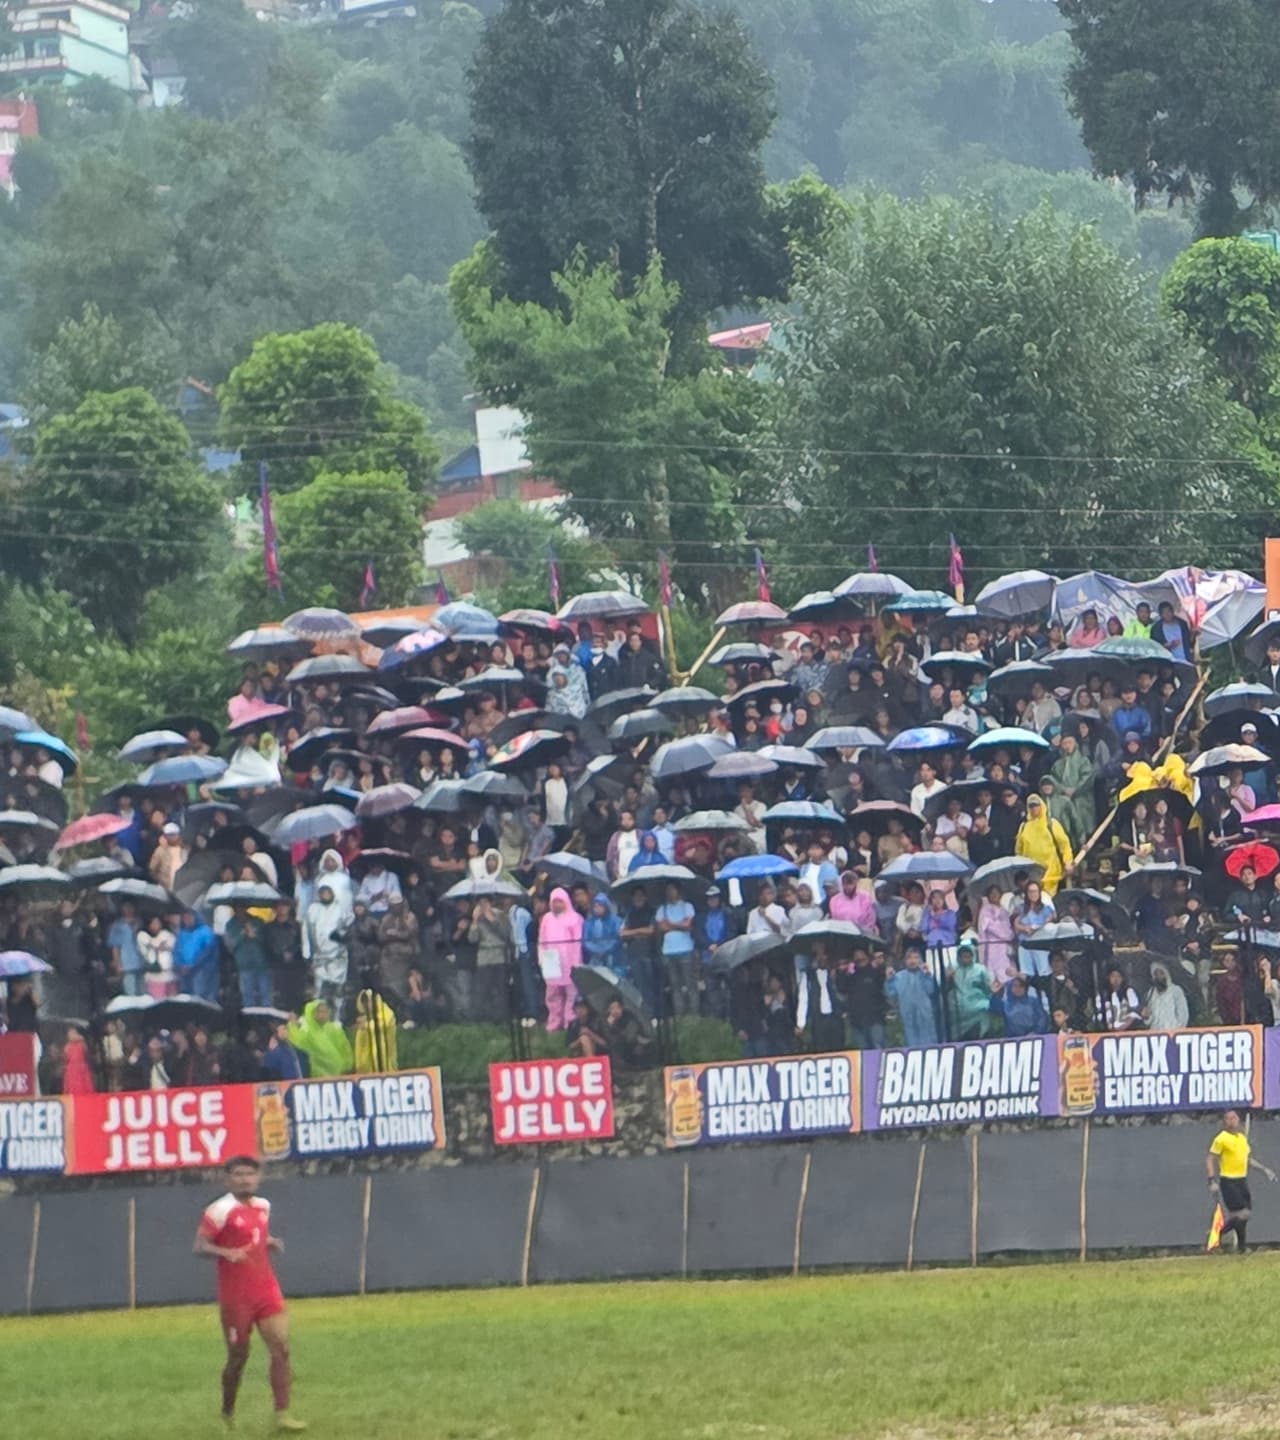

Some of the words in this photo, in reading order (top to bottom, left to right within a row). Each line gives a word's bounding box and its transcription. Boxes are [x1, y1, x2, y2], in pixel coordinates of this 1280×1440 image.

[882, 1048, 955, 1104] BAM
[960, 1039, 1043, 1098] BAM!
[1103, 1035, 1169, 1076] MAX
[1175, 1031, 1253, 1072] TIGER
[294, 1081, 356, 1122] MAX
[359, 1075, 432, 1115] TIGER
[496, 1062, 605, 1102] JUICE
[707, 1064, 771, 1105] MAX
[775, 1058, 850, 1100] TIGER
[1104, 1074, 1184, 1108] ENERGY
[1188, 1070, 1253, 1103] DRINK
[102, 1091, 225, 1132] JUICE
[499, 1099, 607, 1138] JELLY
[708, 1101, 784, 1136] ENERGY
[790, 1096, 851, 1130] DRINK
[879, 1101, 982, 1126] HYDRATION
[984, 1096, 1039, 1118] DRINK
[105, 1128, 227, 1170] JELLY
[297, 1118, 369, 1152] ENERGY
[375, 1113, 435, 1146] DRINK
[7, 1138, 65, 1170] DRINK
